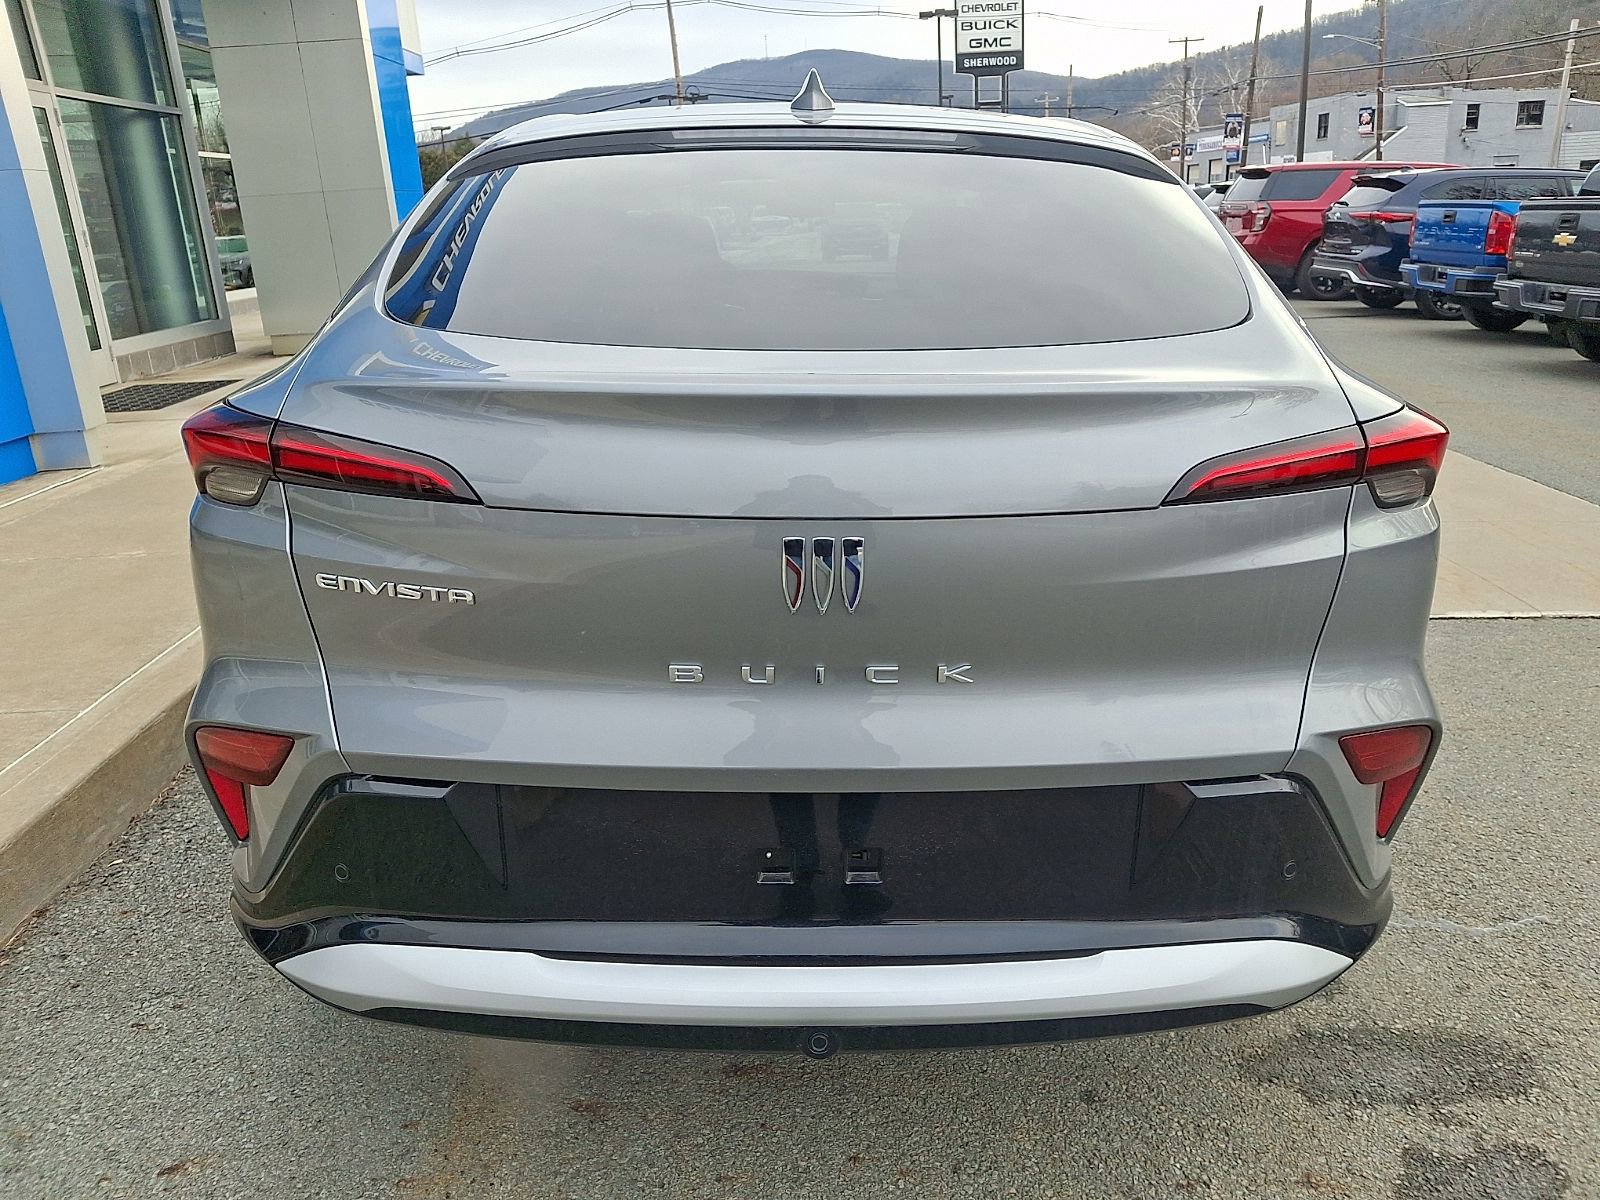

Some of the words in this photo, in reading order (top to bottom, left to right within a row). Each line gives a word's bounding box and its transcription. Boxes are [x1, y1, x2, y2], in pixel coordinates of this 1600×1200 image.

[961, 2, 1019, 13] CHEVROLET
[961, 19, 1019, 31] BUICK
[969, 37, 1012, 49] GMC
[963, 56, 1017, 68] SHERWOOD
[315, 572, 476, 605] ENVISTA
[667, 663, 975, 684] BUICK
